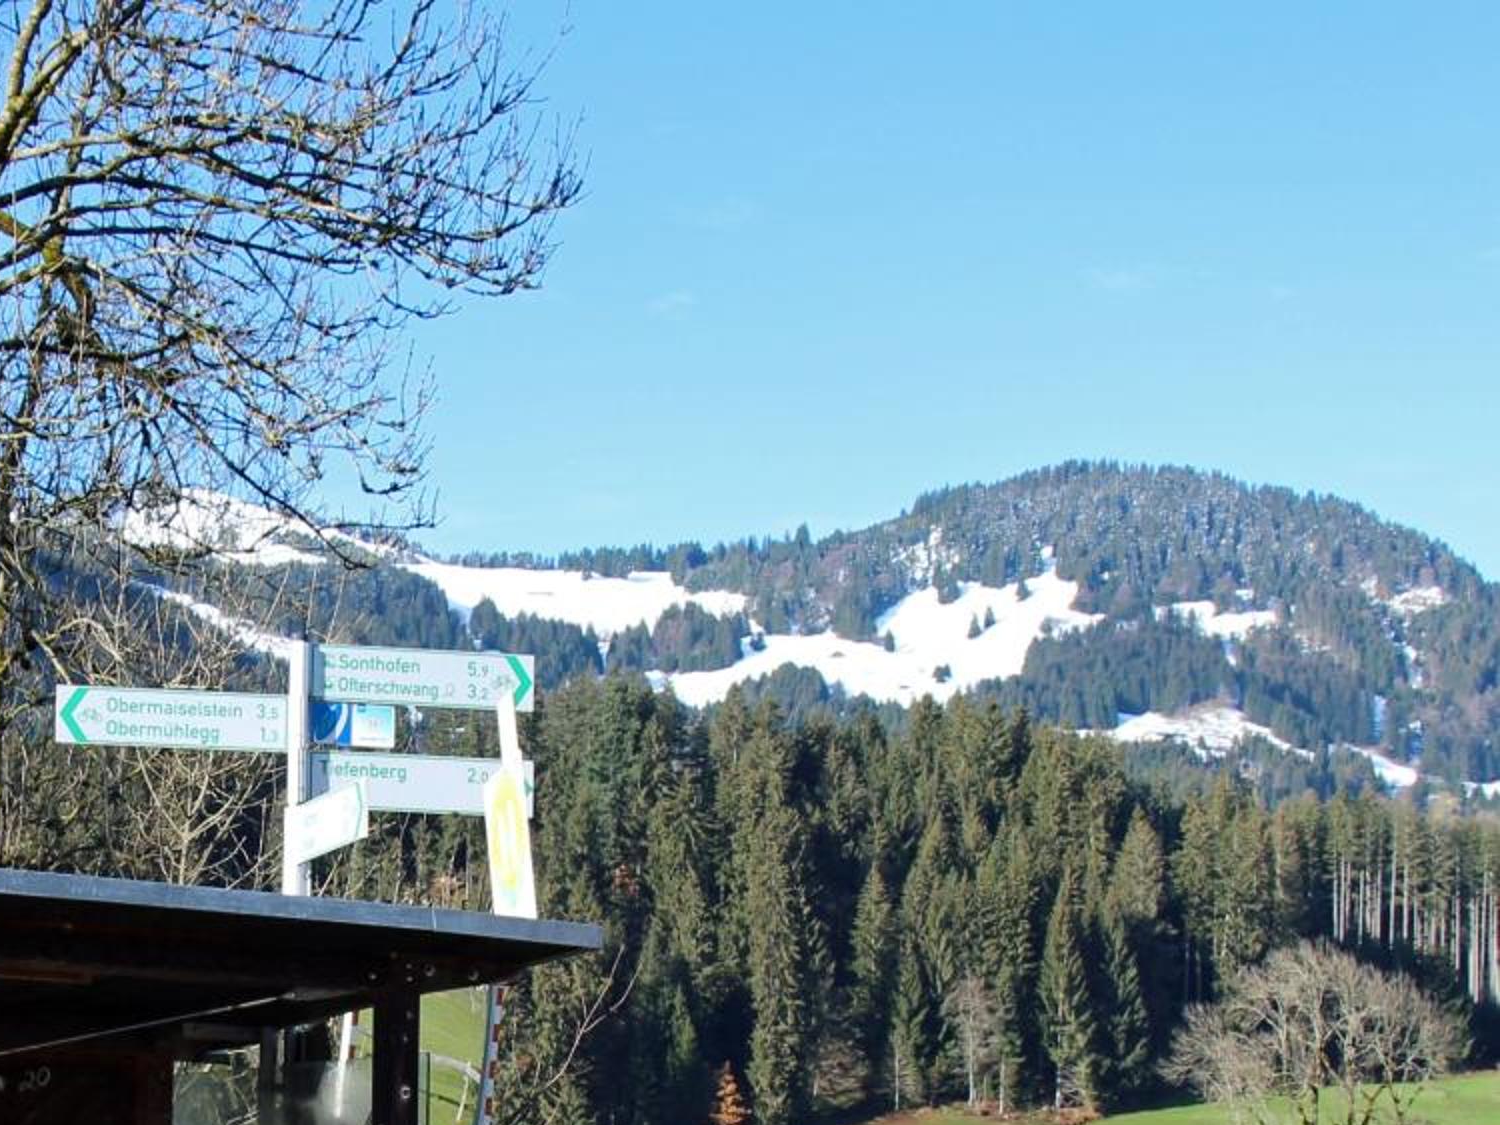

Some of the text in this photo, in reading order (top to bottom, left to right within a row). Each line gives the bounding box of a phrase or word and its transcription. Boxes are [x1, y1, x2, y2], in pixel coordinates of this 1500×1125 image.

[338, 655, 421, 674] Sonthofen
[337, 677, 440, 698] Ofterschwang
[106, 696, 243, 718] Obermaiselstein
[105, 720, 221, 744] Obermühlegg
